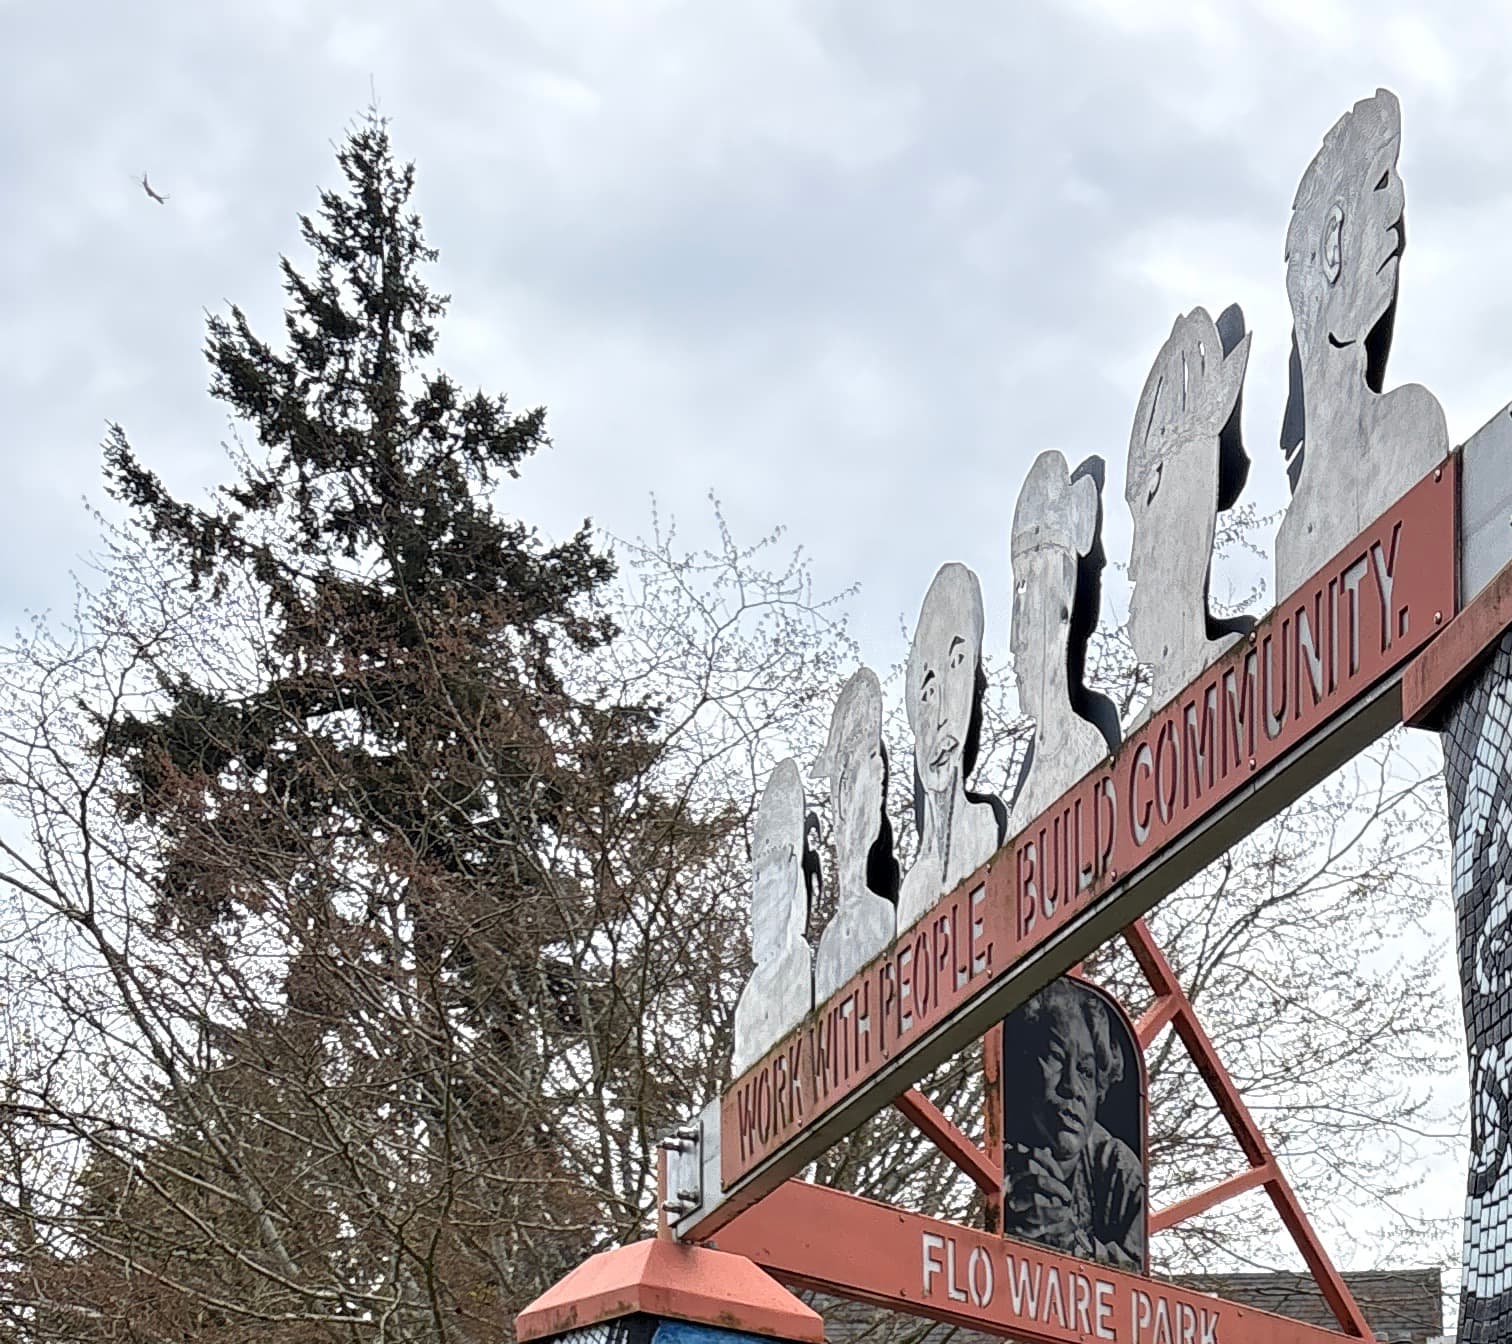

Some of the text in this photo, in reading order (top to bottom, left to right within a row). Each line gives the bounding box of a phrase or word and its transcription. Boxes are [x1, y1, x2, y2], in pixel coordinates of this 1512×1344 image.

[736, 1034, 804, 1162] WORK
[809, 978, 870, 1105] WITH
[1015, 776, 1119, 942] BUILD
[1129, 520, 1412, 848] COMMUNITY.
[921, 1231, 995, 1310] FLO
[1004, 1253, 1118, 1342] WARE
